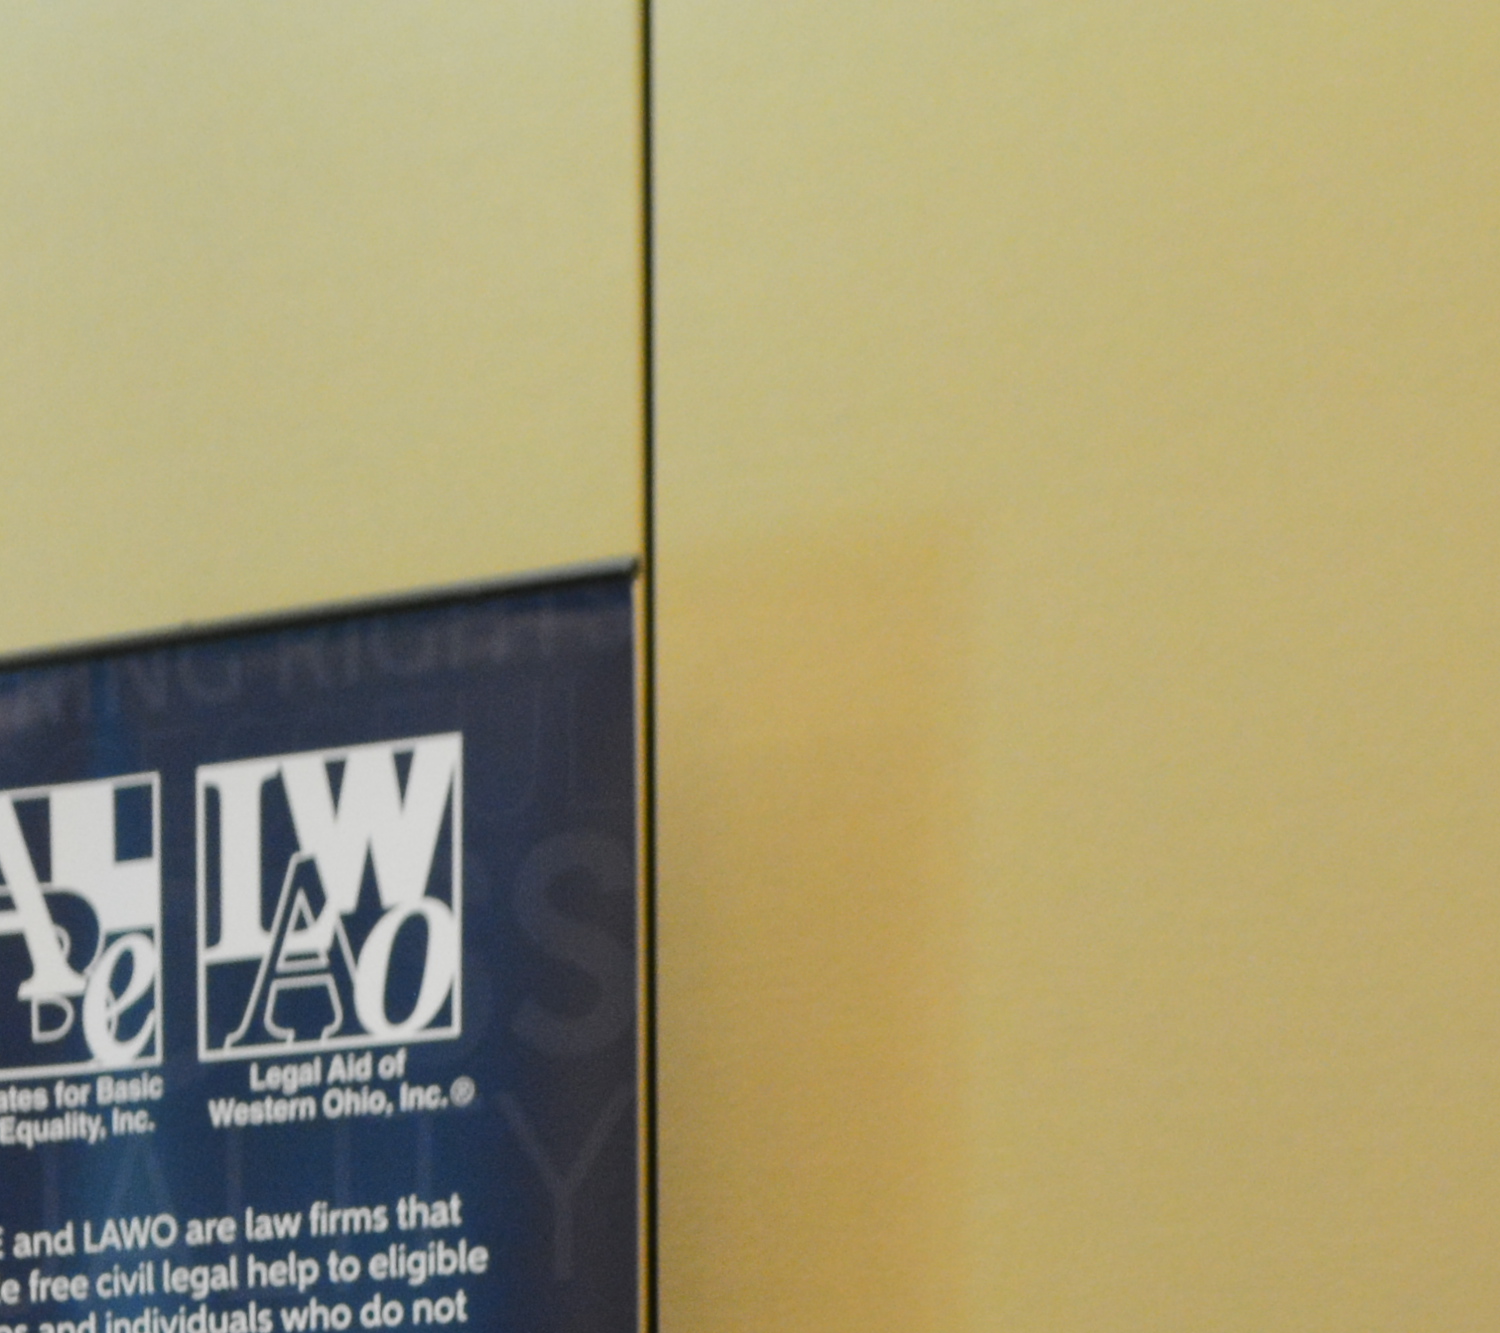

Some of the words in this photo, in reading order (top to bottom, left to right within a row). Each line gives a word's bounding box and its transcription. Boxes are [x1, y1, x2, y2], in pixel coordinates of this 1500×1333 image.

[55, 1080, 91, 1108] for
[96, 1072, 164, 1104] Basic
[250, 1056, 321, 1095] Legal
[327, 1051, 372, 1084] Aid
[378, 1047, 407, 1080] of
[112, 1107, 154, 1134] Inc.
[208, 1095, 317, 1127] Western
[322, 1086, 393, 1119] Ohio,
[12, 1220, 75, 1259] and
[83, 1213, 178, 1254] LAWO
[185, 1216, 237, 1246] are
[245, 1206, 301, 1242] law
[309, 1201, 389, 1237] firms
[397, 1192, 463, 1230] that
[29, 1269, 89, 1303] free
[96, 1260, 154, 1298] civil
[162, 1254, 238, 1300] legal
[247, 1250, 320, 1293] help
[328, 1250, 361, 1283] to
[368, 1238, 489, 1286] eligible
[281, 1296, 352, 1333] who
[360, 1292, 403, 1328] do
[412, 1289, 468, 1325] not
